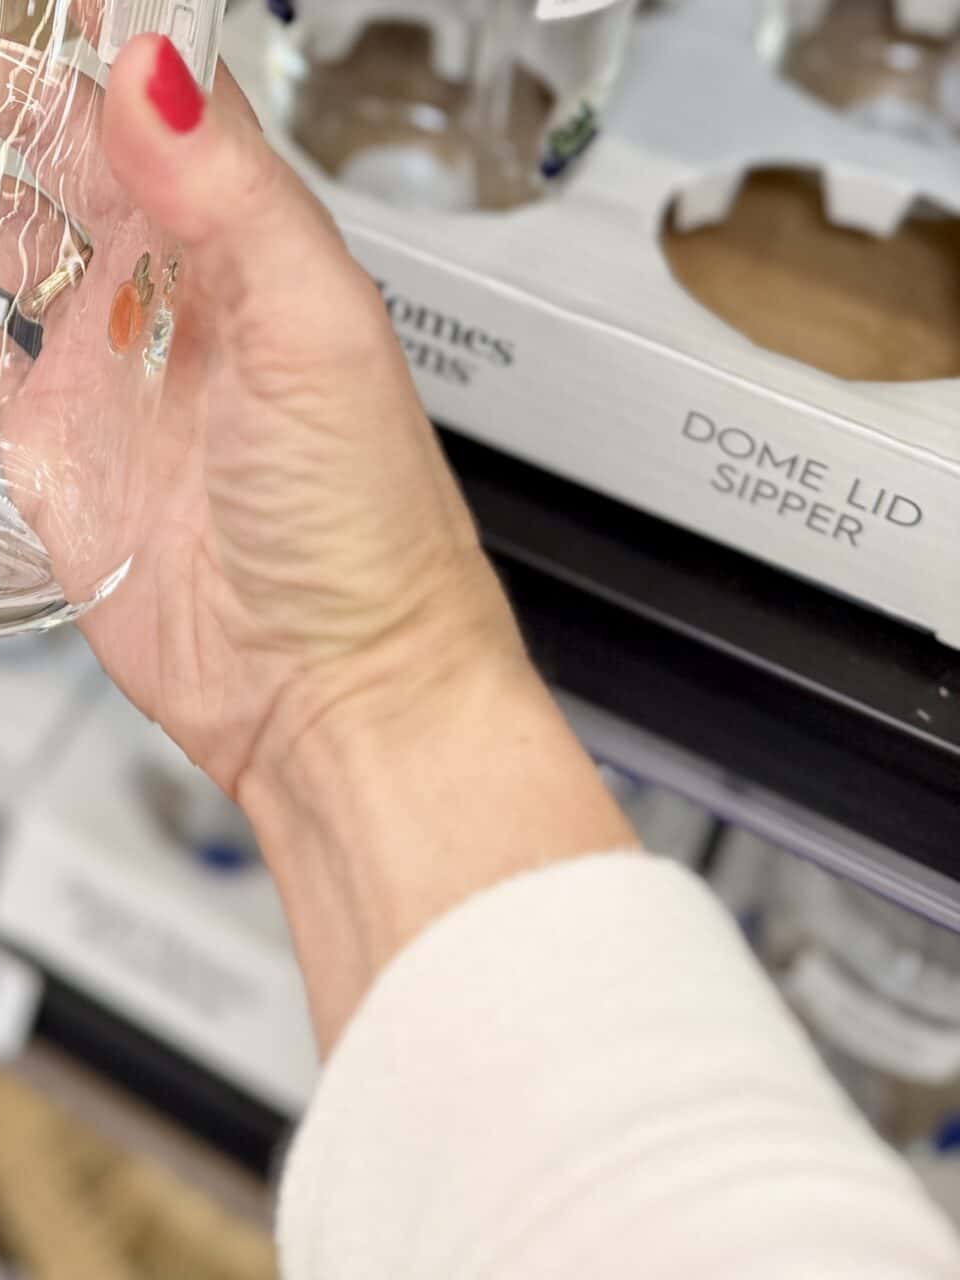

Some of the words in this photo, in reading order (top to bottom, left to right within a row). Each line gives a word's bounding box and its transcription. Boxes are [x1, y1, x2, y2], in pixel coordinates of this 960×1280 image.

[376, 280, 514, 368] omes
[681, 410, 830, 494] DOME
[845, 477, 923, 529] LID
[710, 461, 865, 549] SIPPER
